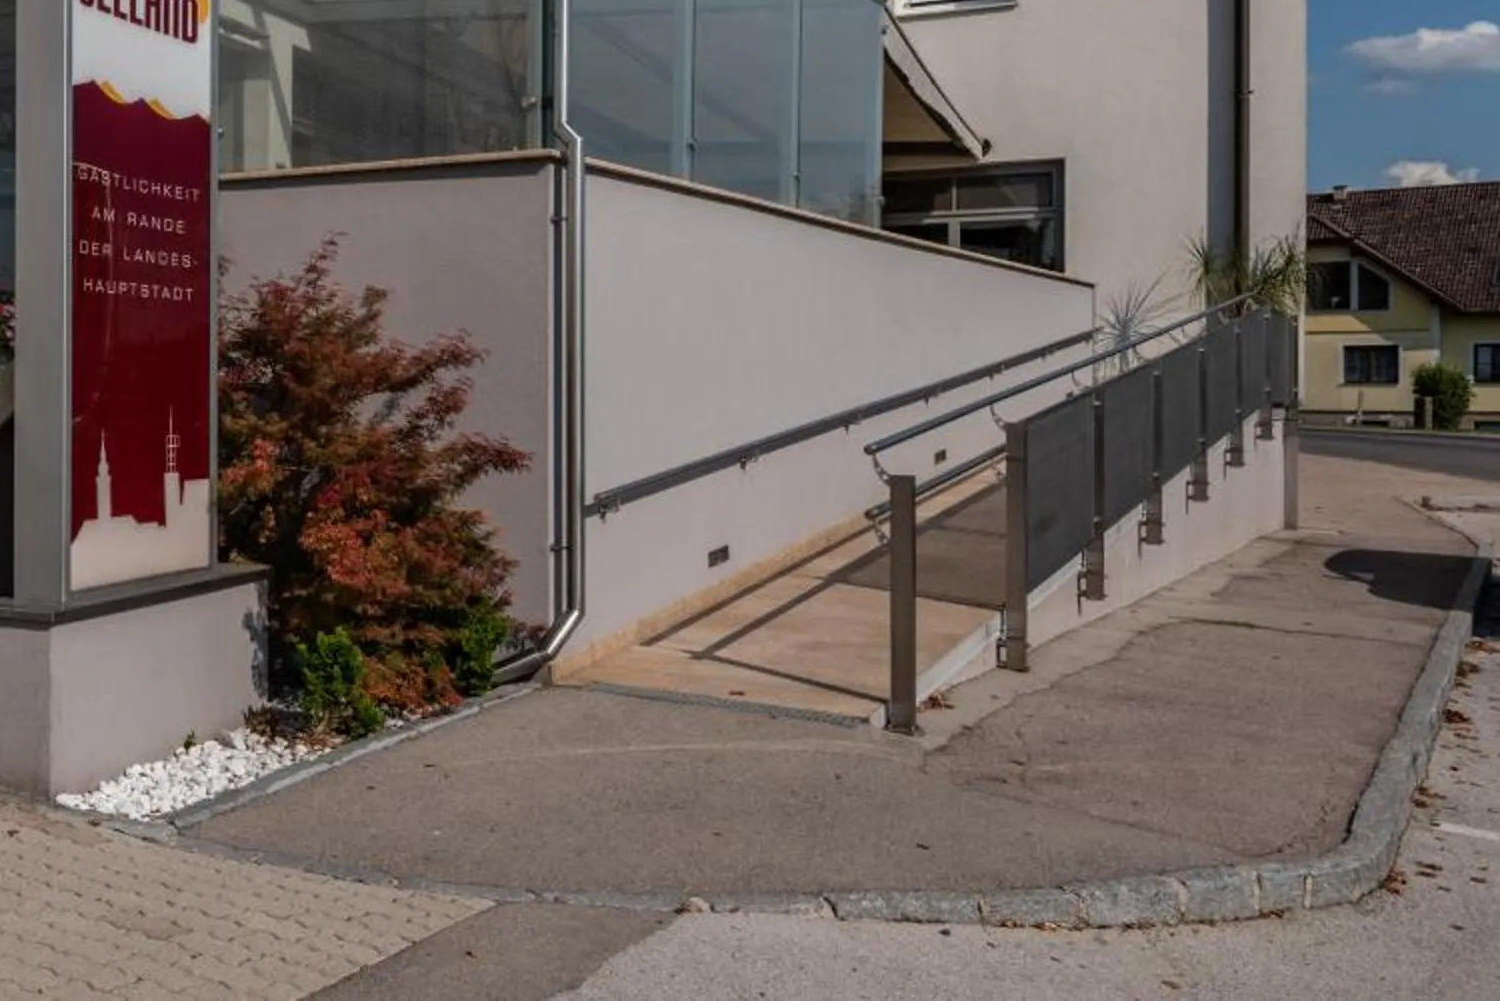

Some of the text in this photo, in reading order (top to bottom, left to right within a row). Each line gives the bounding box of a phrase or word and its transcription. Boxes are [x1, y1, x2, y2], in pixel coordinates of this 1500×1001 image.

[78, 165, 201, 202] GASTLICHKEIT
[91, 206, 186, 234] AM RANDE
[79, 239, 198, 268] DER LANDES-
[83, 278, 194, 301] HAUPTSTADT
